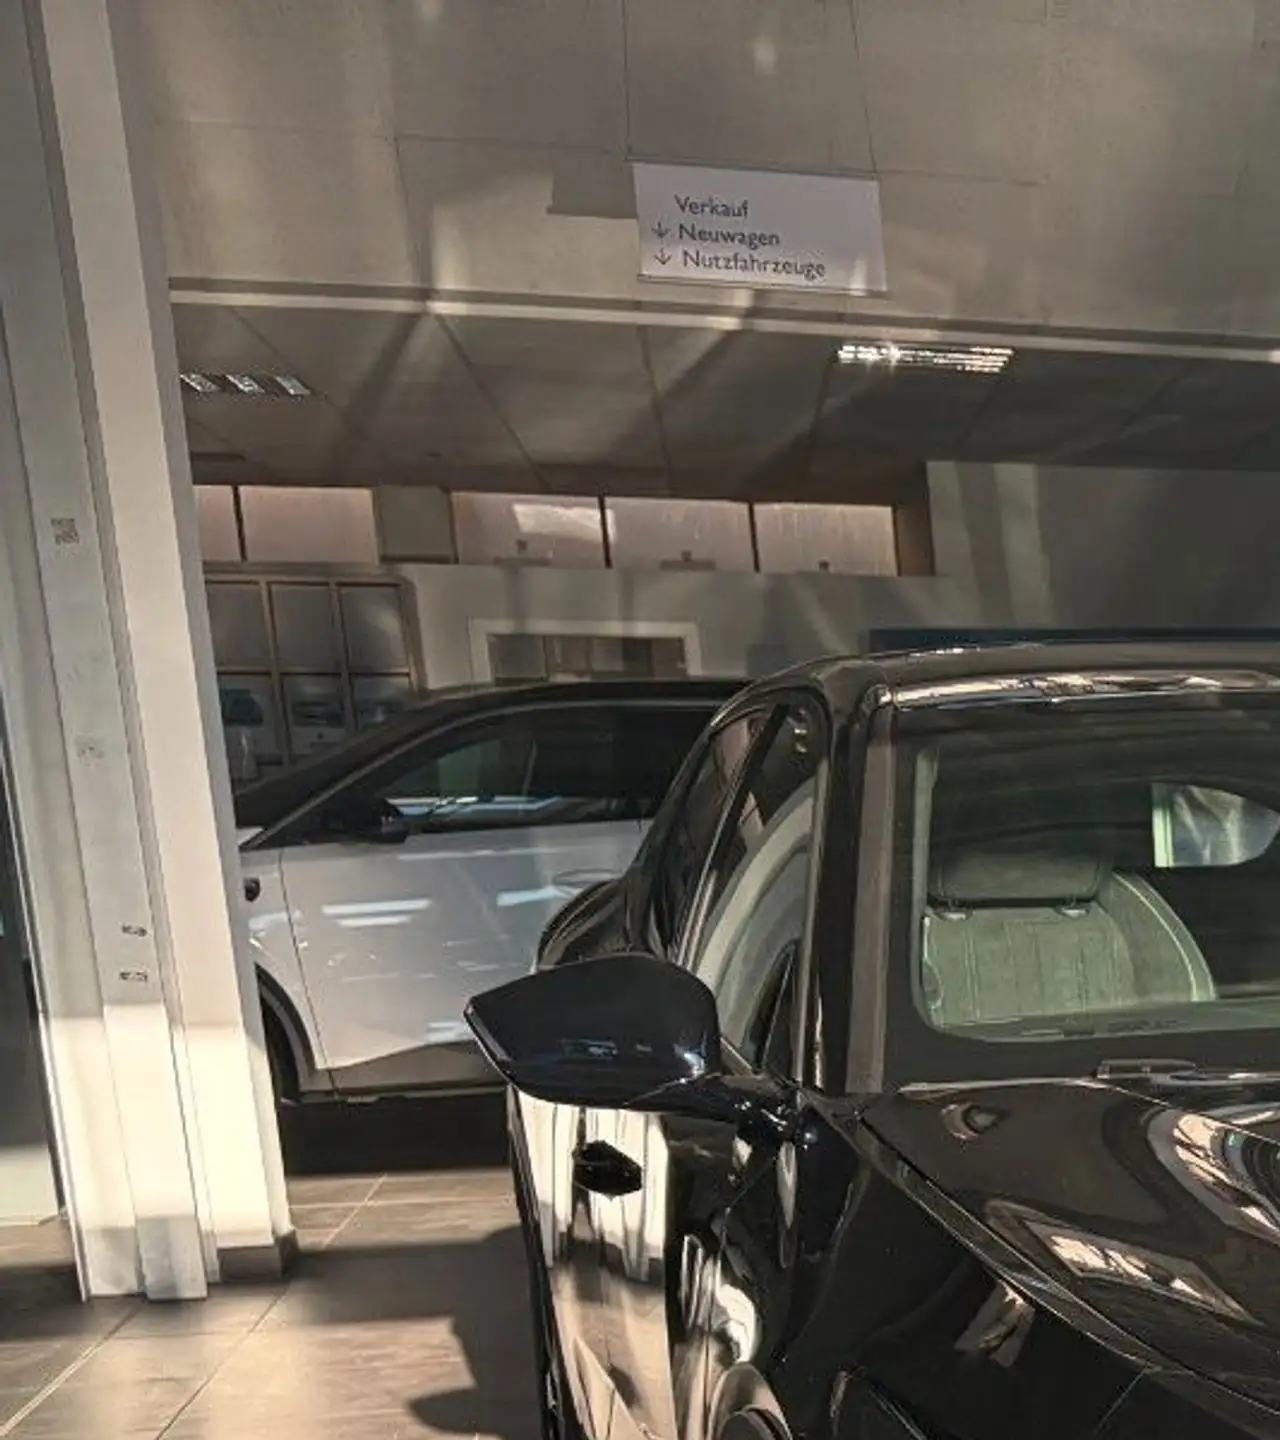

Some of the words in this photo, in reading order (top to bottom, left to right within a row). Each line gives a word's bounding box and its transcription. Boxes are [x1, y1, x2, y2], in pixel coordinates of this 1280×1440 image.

[674, 194, 749, 218] Verkauf
[678, 223, 780, 250] Neuwagen
[682, 250, 826, 281] Nutzfahrzeuge
